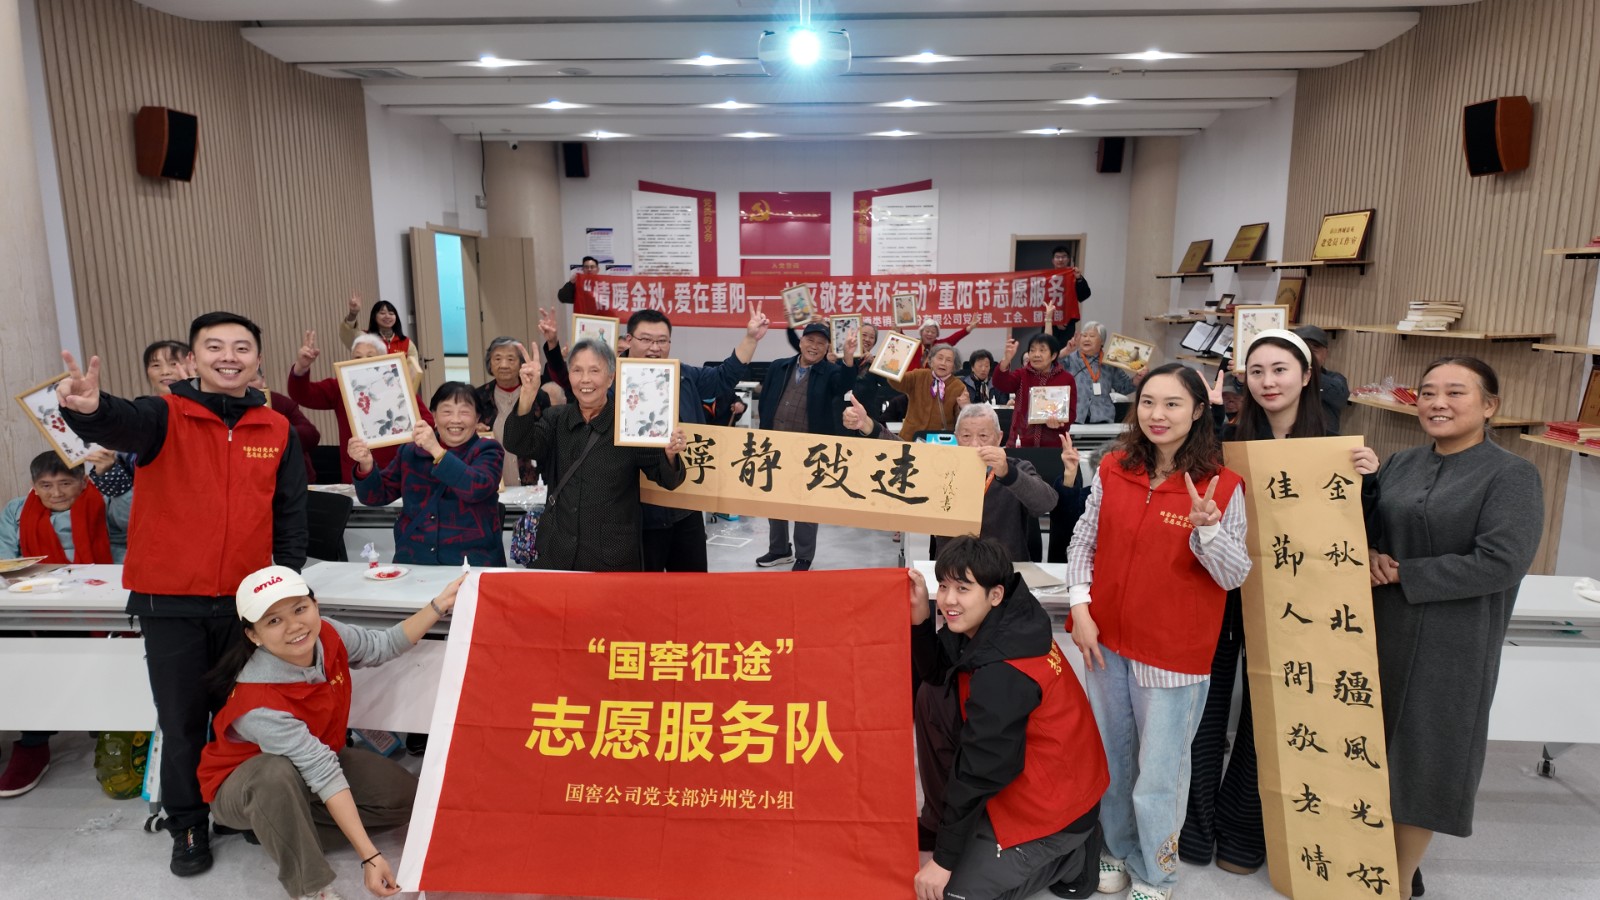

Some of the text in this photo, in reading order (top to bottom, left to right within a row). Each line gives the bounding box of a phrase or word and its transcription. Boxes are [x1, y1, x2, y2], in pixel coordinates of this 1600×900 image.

[253, 576, 283, 594] emis
[587, 637, 795, 682] “国窖征途”
[524, 696, 844, 765] 志愿服务队
[564, 783, 796, 810] 国窖公司党支部泸州党小组
